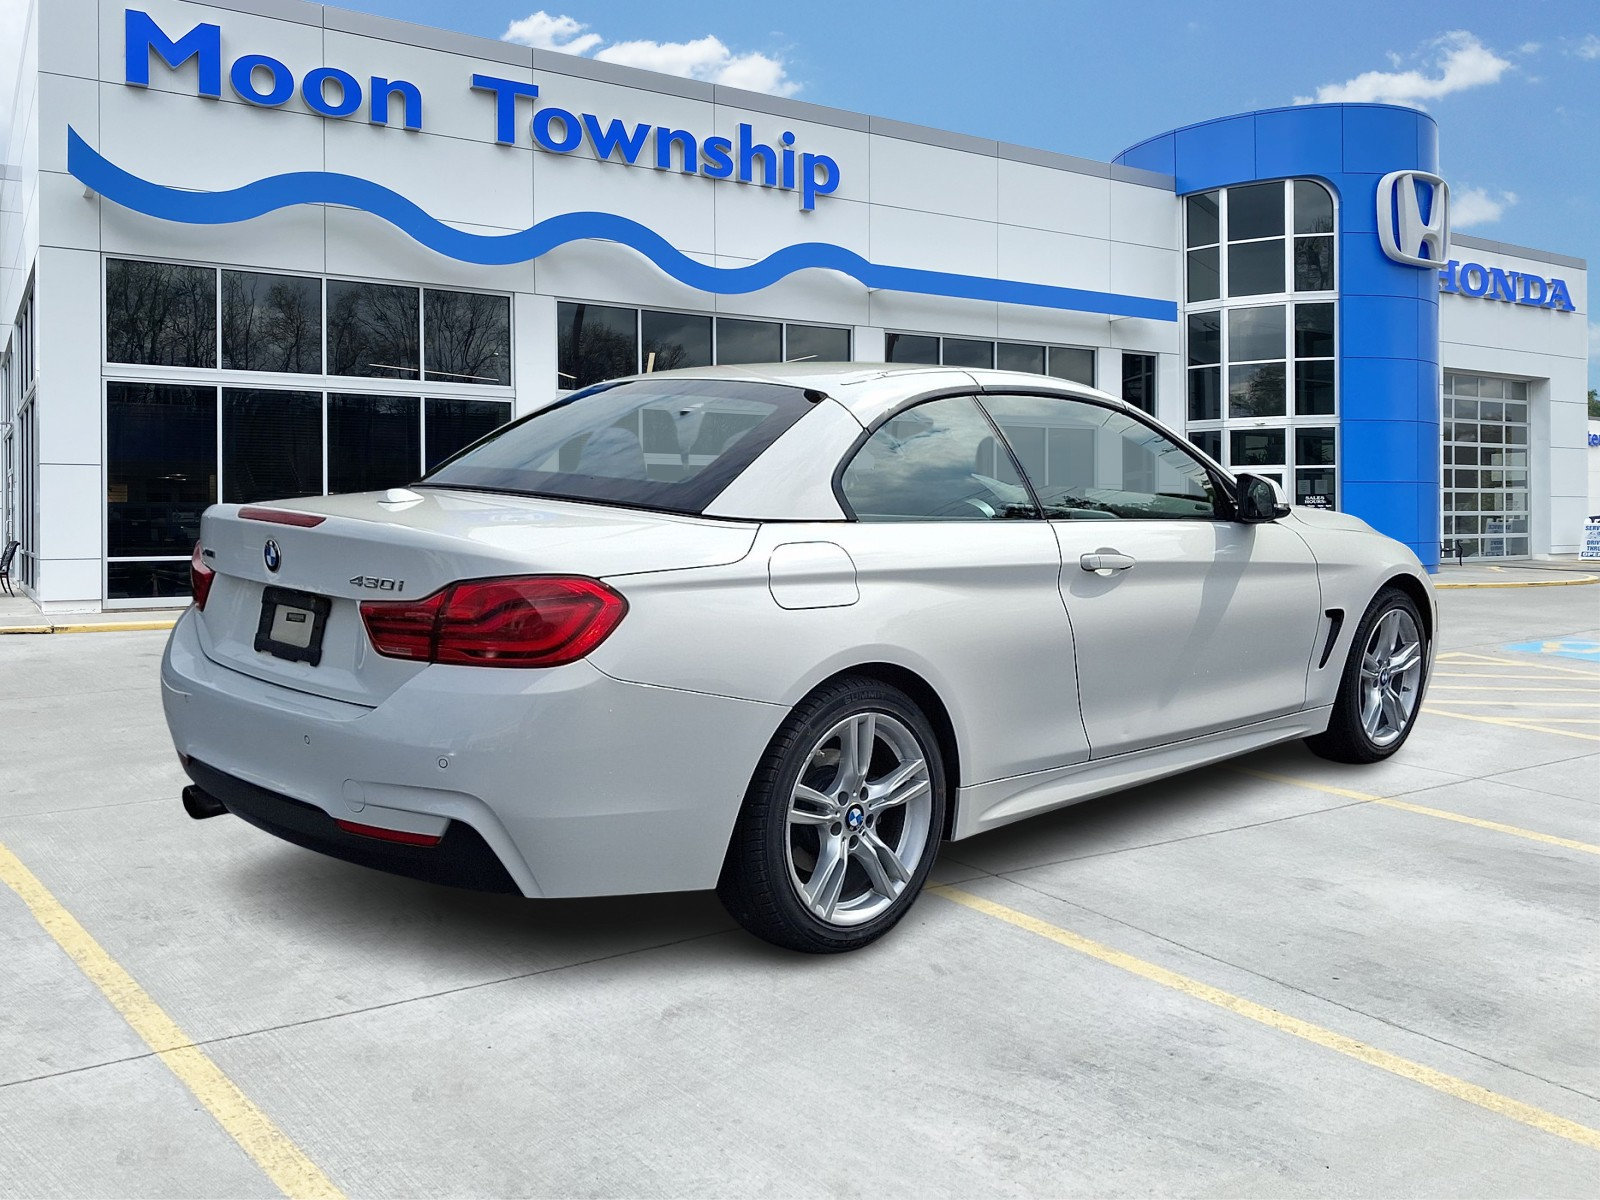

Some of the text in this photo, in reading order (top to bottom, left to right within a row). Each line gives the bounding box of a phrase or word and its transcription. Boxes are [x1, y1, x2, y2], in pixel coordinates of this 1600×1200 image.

[124, 9, 840, 210] Moon Township
[350, 575, 404, 592] 430i
